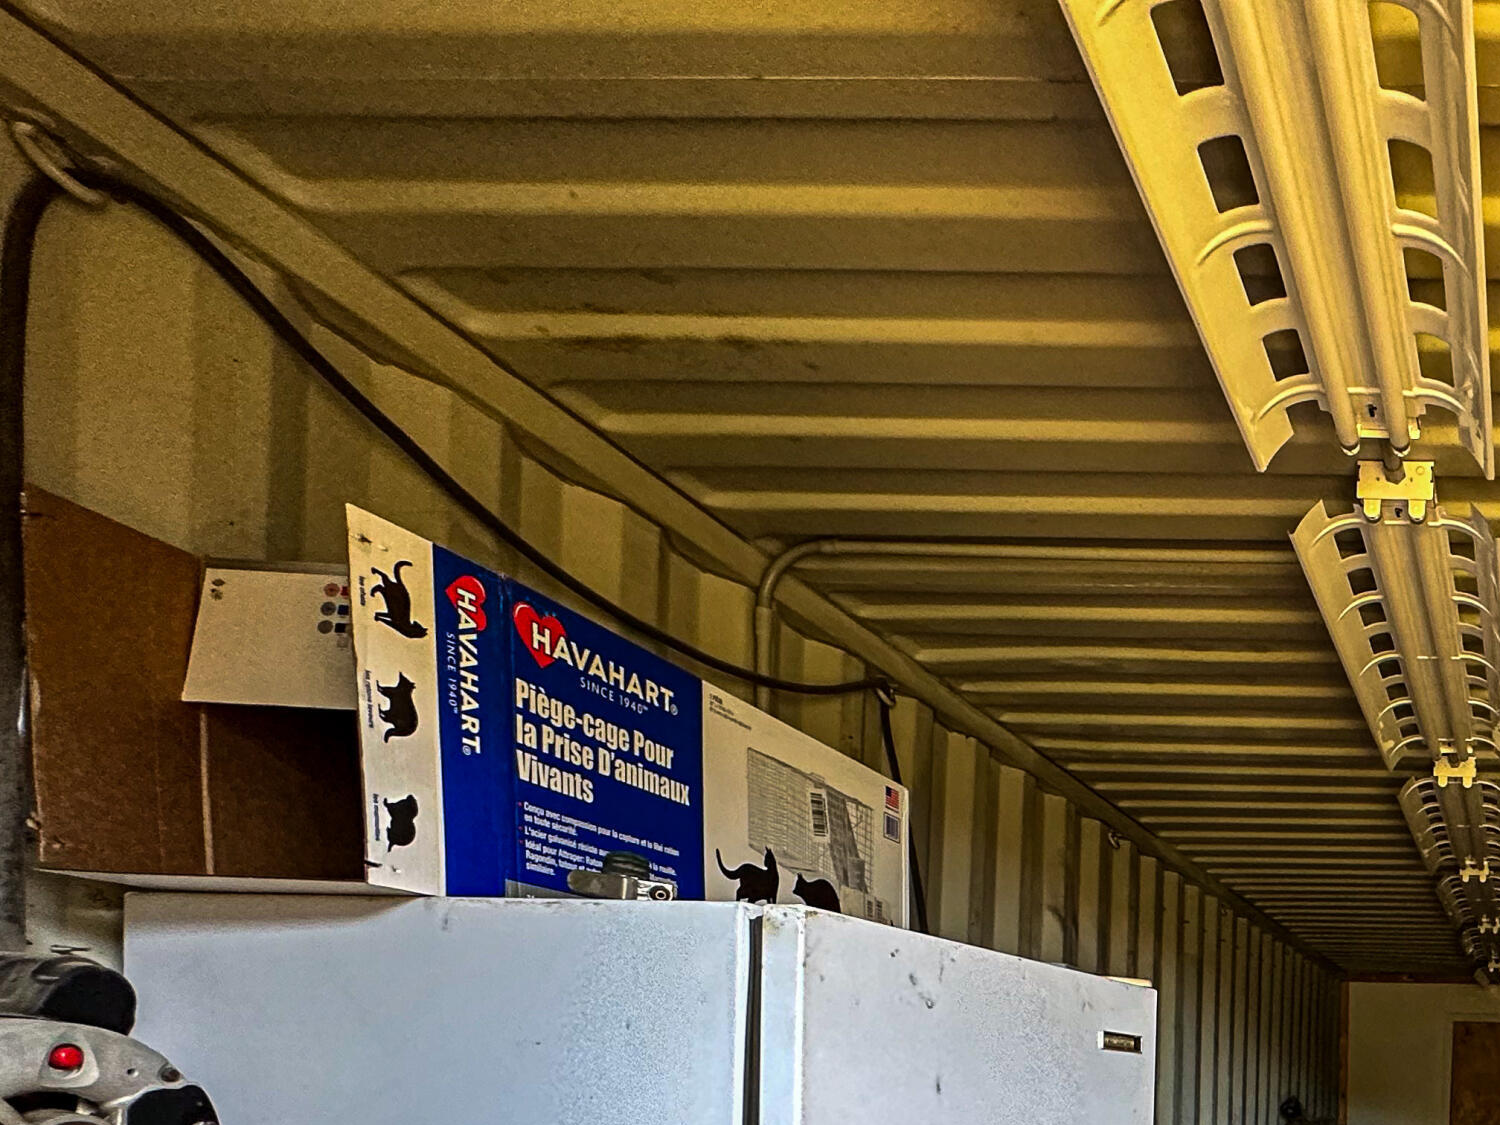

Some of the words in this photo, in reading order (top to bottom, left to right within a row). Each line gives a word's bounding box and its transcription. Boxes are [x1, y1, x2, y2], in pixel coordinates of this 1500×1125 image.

[446, 632, 457, 673] SINCE
[580, 676, 615, 702] SINCE
[515, 678, 630, 752] Piège-cage
[633, 729, 675, 769] Pour
[516, 714, 537, 749] la
[541, 724, 594, 770] Prise
[598, 748, 690, 806] D'animaux
[516, 749, 594, 803] Vivants
